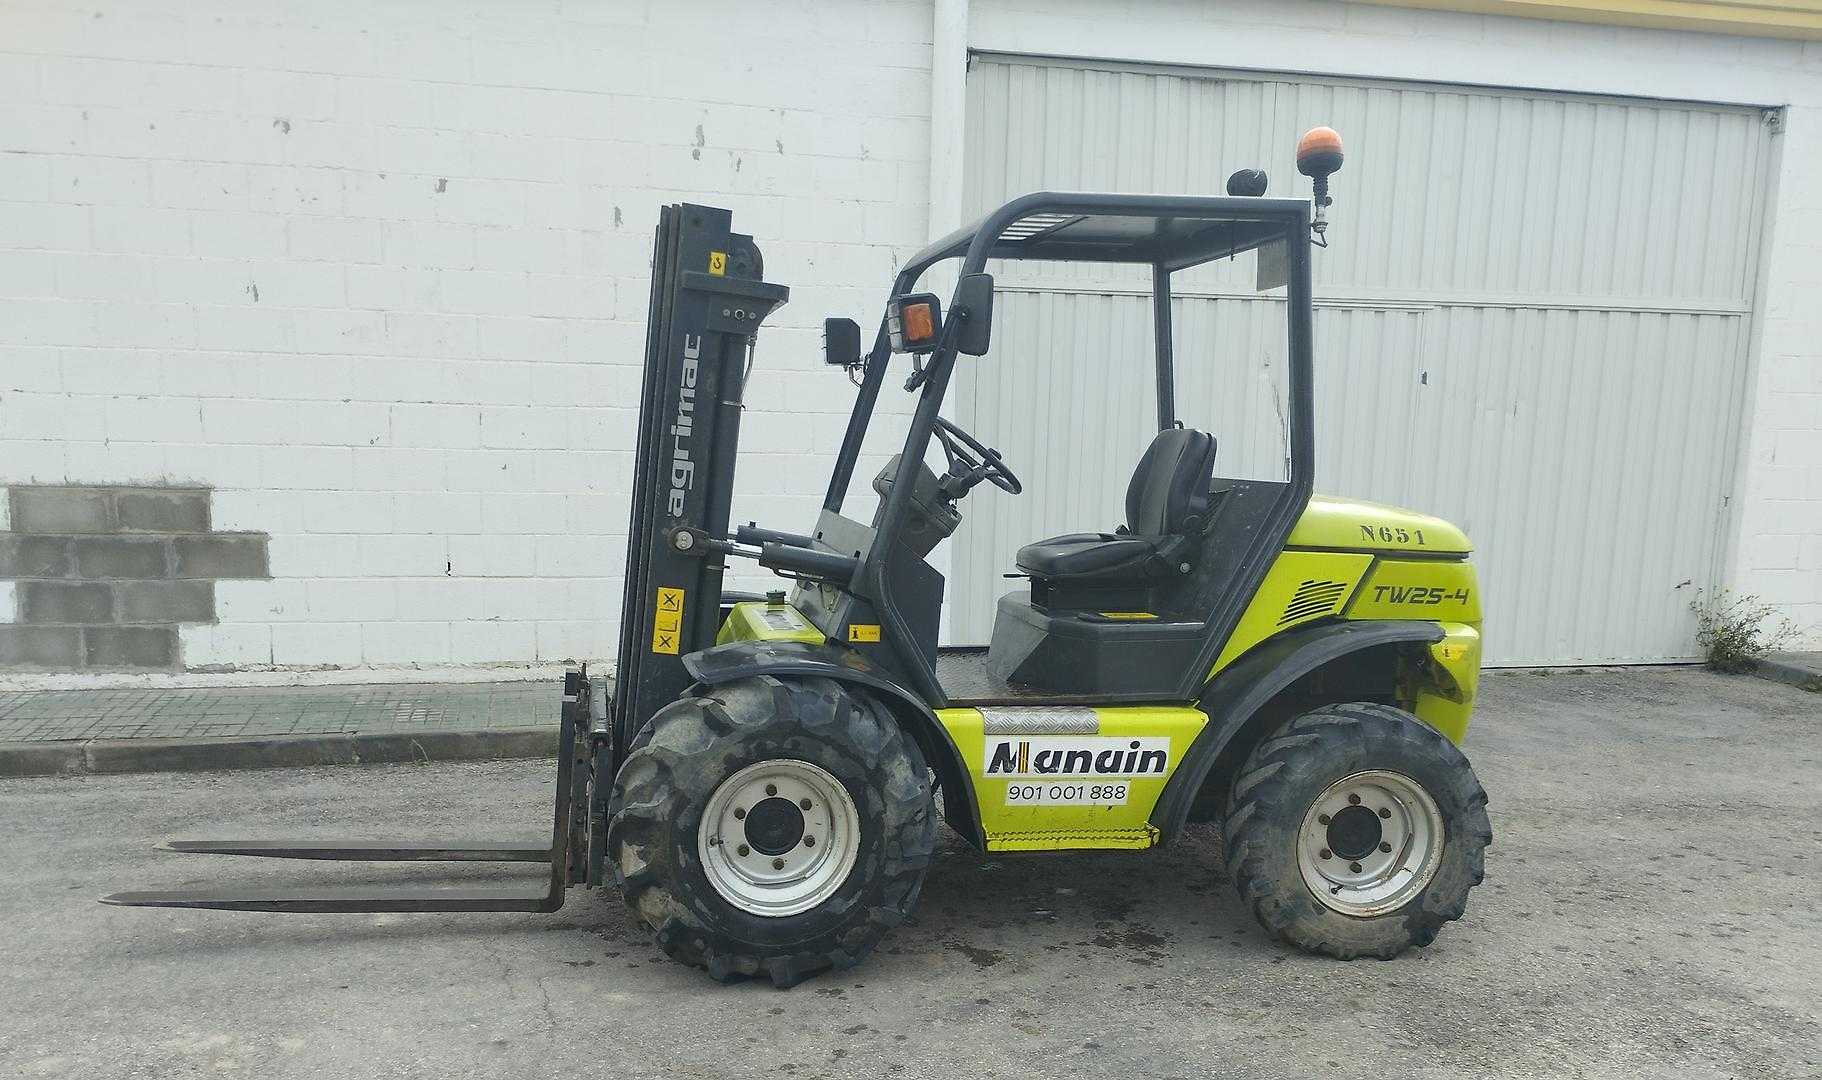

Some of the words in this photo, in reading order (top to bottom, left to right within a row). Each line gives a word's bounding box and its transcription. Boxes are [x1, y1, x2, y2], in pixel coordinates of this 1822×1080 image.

[668, 334, 701, 517] agrimac
[1360, 525, 1425, 545] N651
[1374, 585, 1469, 605] TW25-4
[987, 740, 1167, 774] Manain
[1008, 785, 1043, 800] 901
[1049, 785, 1084, 800] 001
[1090, 785, 1126, 800] 888
